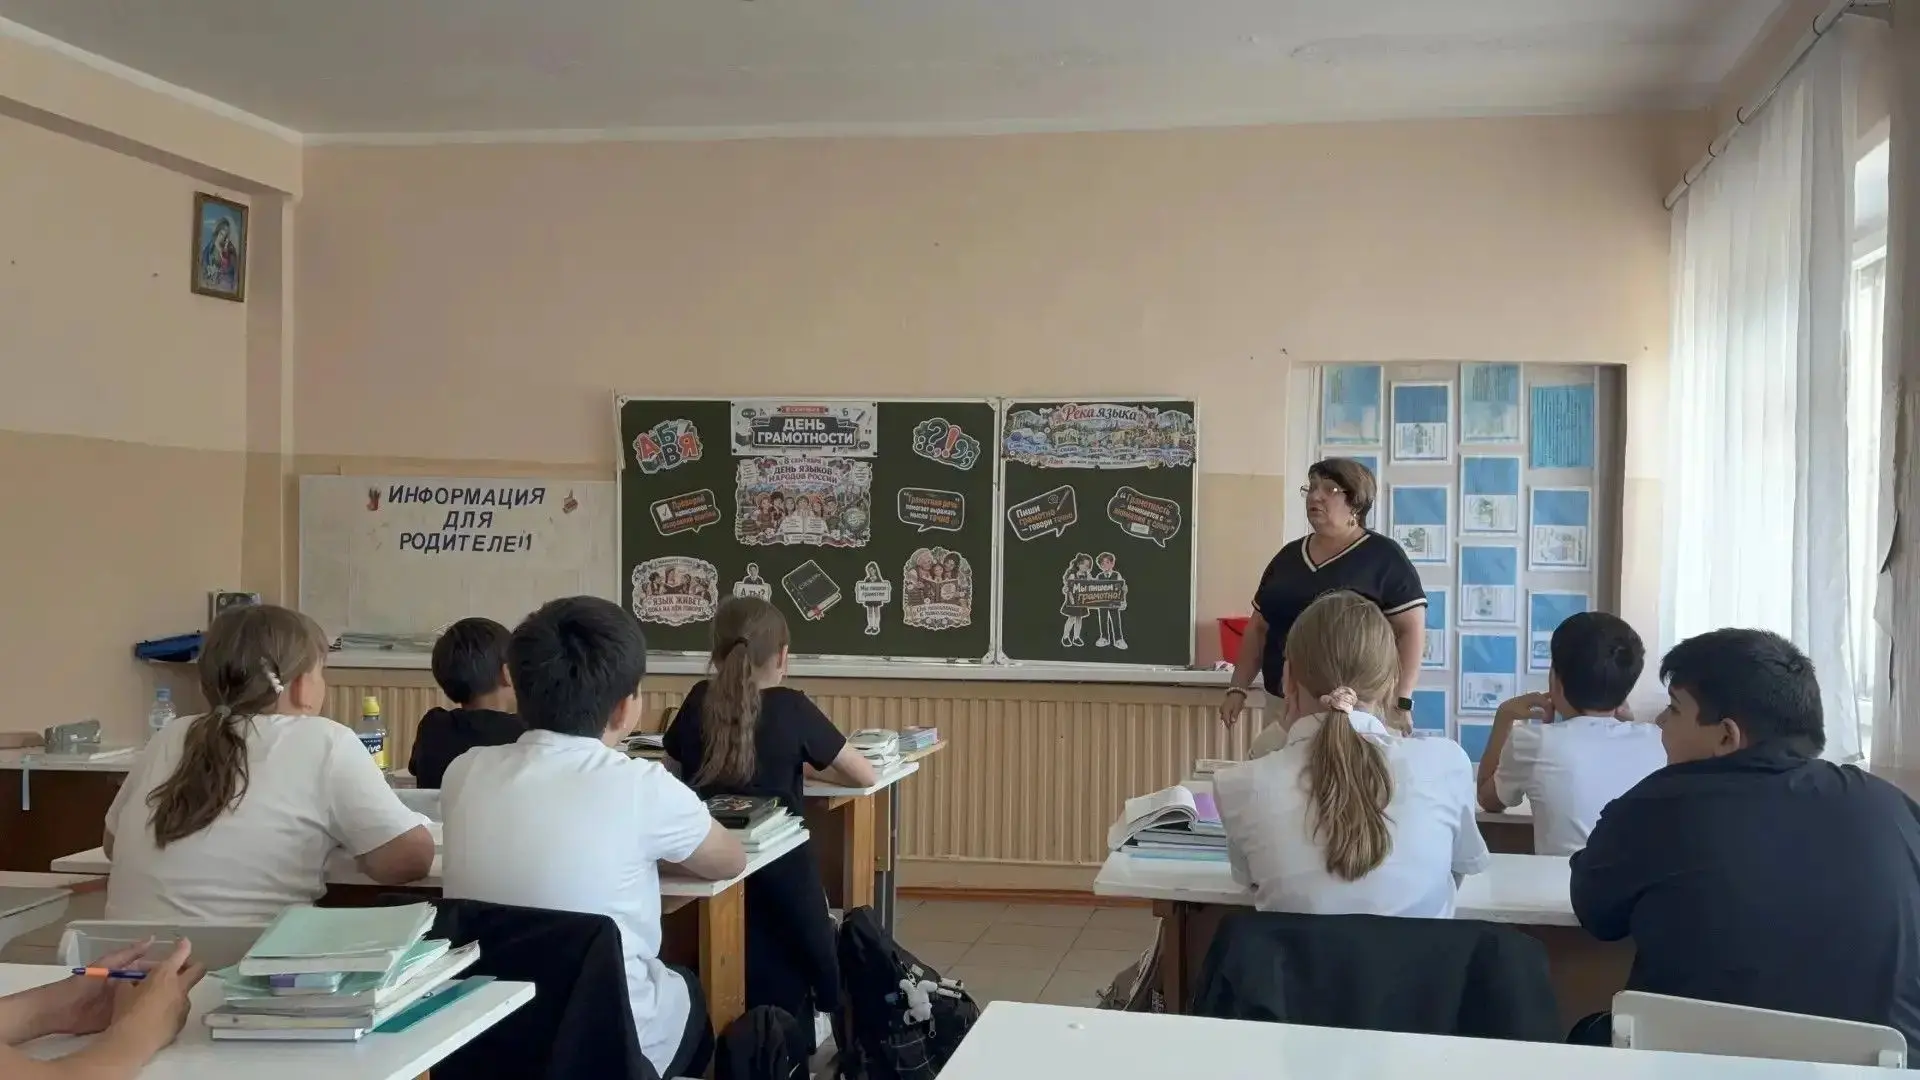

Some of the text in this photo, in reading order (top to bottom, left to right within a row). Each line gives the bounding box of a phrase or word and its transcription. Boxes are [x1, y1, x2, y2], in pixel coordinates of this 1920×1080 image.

[1062, 404, 1137, 421] Река языка
[783, 418, 825, 431] ДЕНЬ
[757, 432, 854, 444] ГРАМОТНОСТИ
[774, 465, 833, 475] ДЕНЬ ЯЗЫКОВ
[388, 485, 546, 509] ИНФОРМАЦИЯ
[1016, 505, 1040, 518] Пиши
[443, 510, 493, 531] ДЛЯ
[1029, 518, 1053, 531] говори
[1073, 583, 1114, 593] Мы пишем
